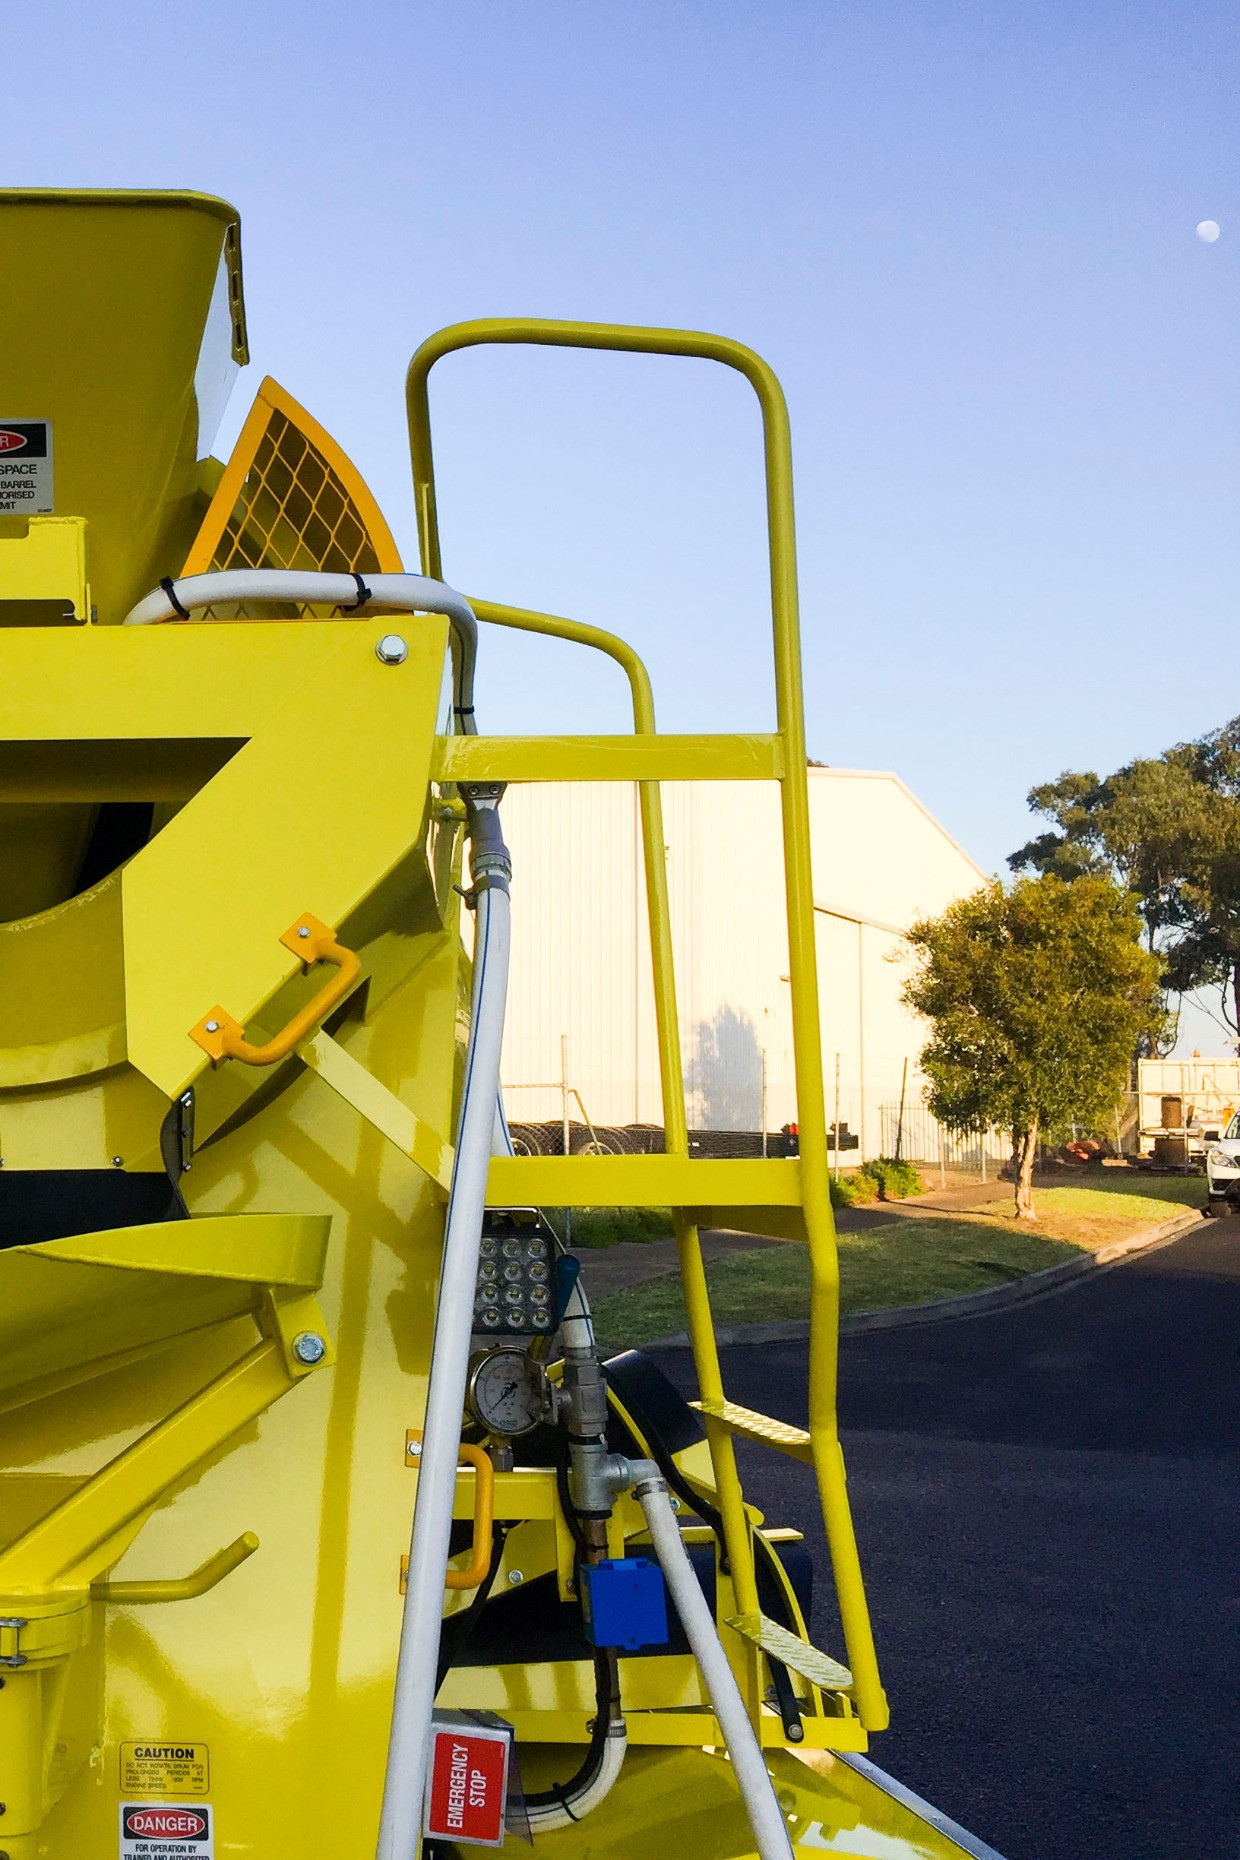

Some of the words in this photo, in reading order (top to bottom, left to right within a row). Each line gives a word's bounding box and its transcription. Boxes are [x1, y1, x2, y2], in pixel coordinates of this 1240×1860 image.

[0, 480, 37, 489] BARREL
[134, 1747, 194, 1759] CAUTION
[447, 1743, 469, 1829] EMERGENCY
[469, 1769, 487, 1807] STOP
[133, 1816, 198, 1832] DANGER
[135, 1843, 149, 1852] FOR
[150, 1844, 186, 1853] OPERATION
[188, 1845, 197, 1853] BY
